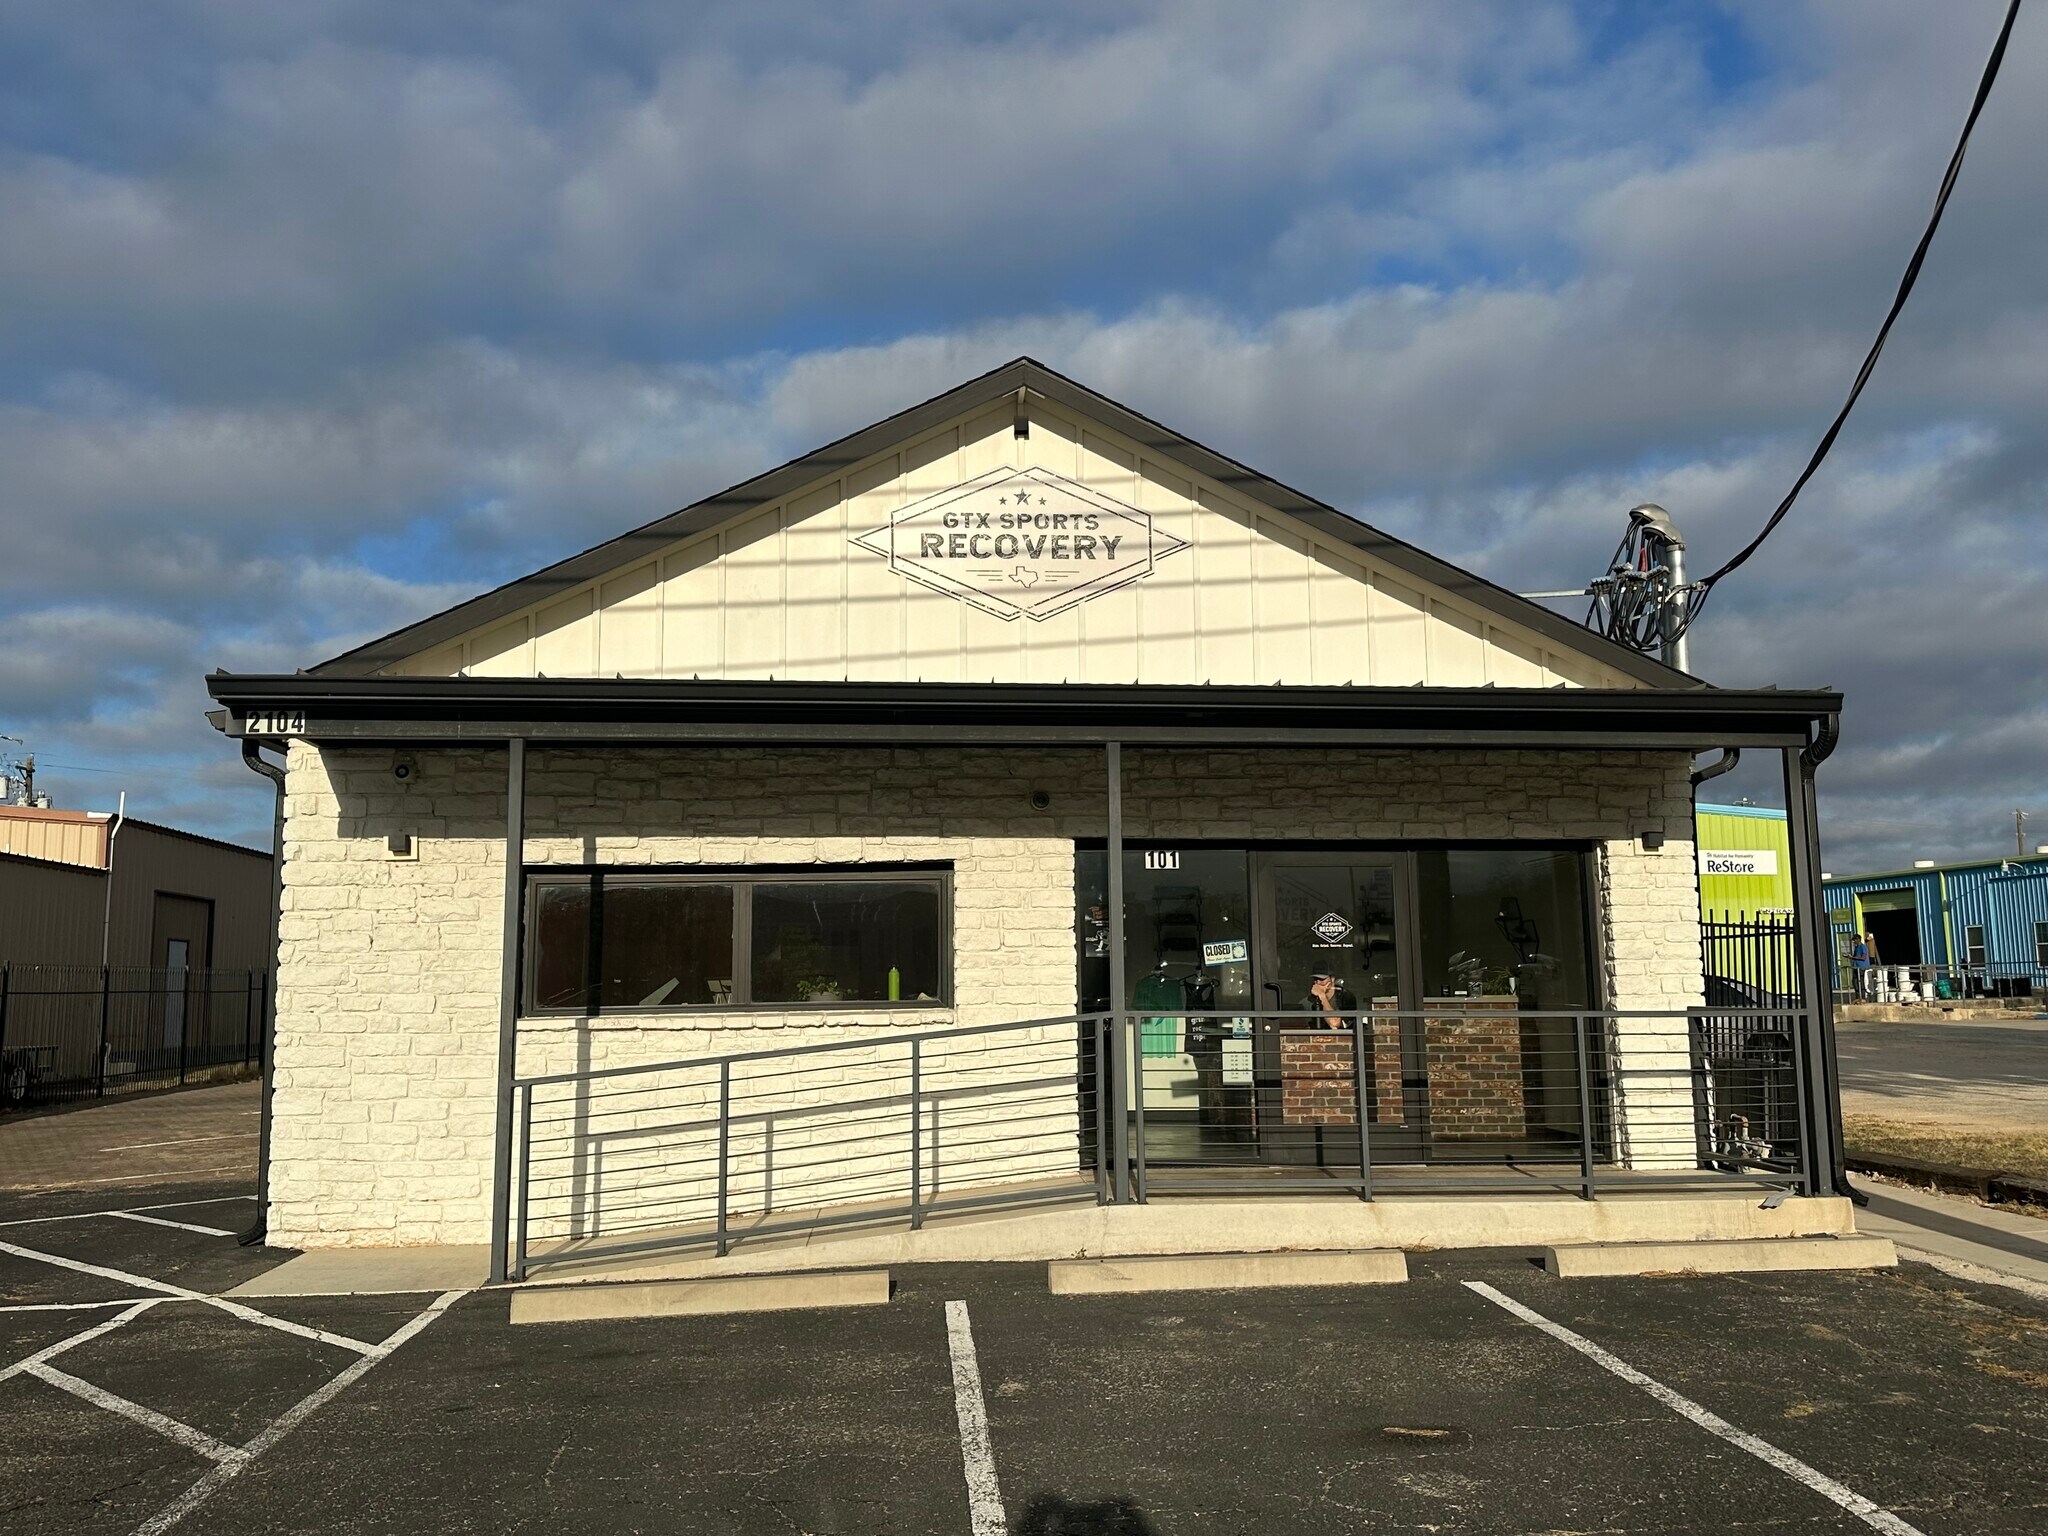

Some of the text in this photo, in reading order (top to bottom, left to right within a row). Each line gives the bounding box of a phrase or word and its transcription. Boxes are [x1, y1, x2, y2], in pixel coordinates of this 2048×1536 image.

[943, 512, 1100, 531] GTX SPORTS
[920, 532, 1124, 561] RECOVERY
[248, 710, 304, 733] 2104
[1147, 850, 1177, 869] 101
[1707, 859, 1754, 873] ReStore
[1205, 944, 1231, 957] CLOSED
